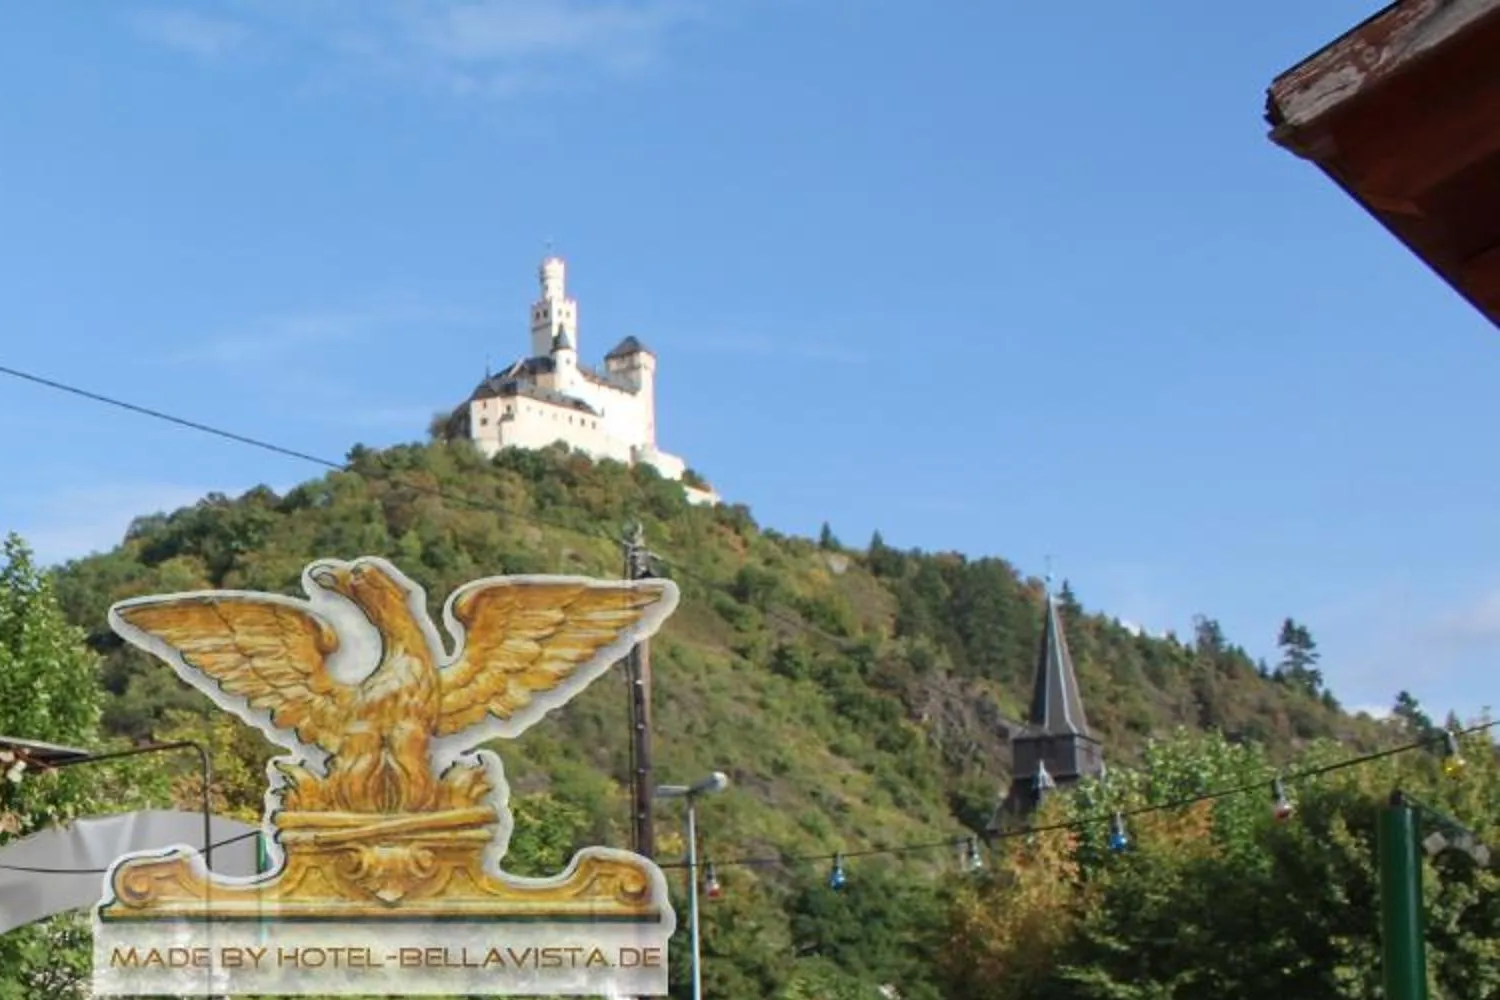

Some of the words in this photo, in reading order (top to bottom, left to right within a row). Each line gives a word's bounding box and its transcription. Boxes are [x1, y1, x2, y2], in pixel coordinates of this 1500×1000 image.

[110, 947, 211, 968] MADE
[221, 947, 267, 968] BY
[277, 947, 661, 968] HOTEL-BELLAVISTA.DE
